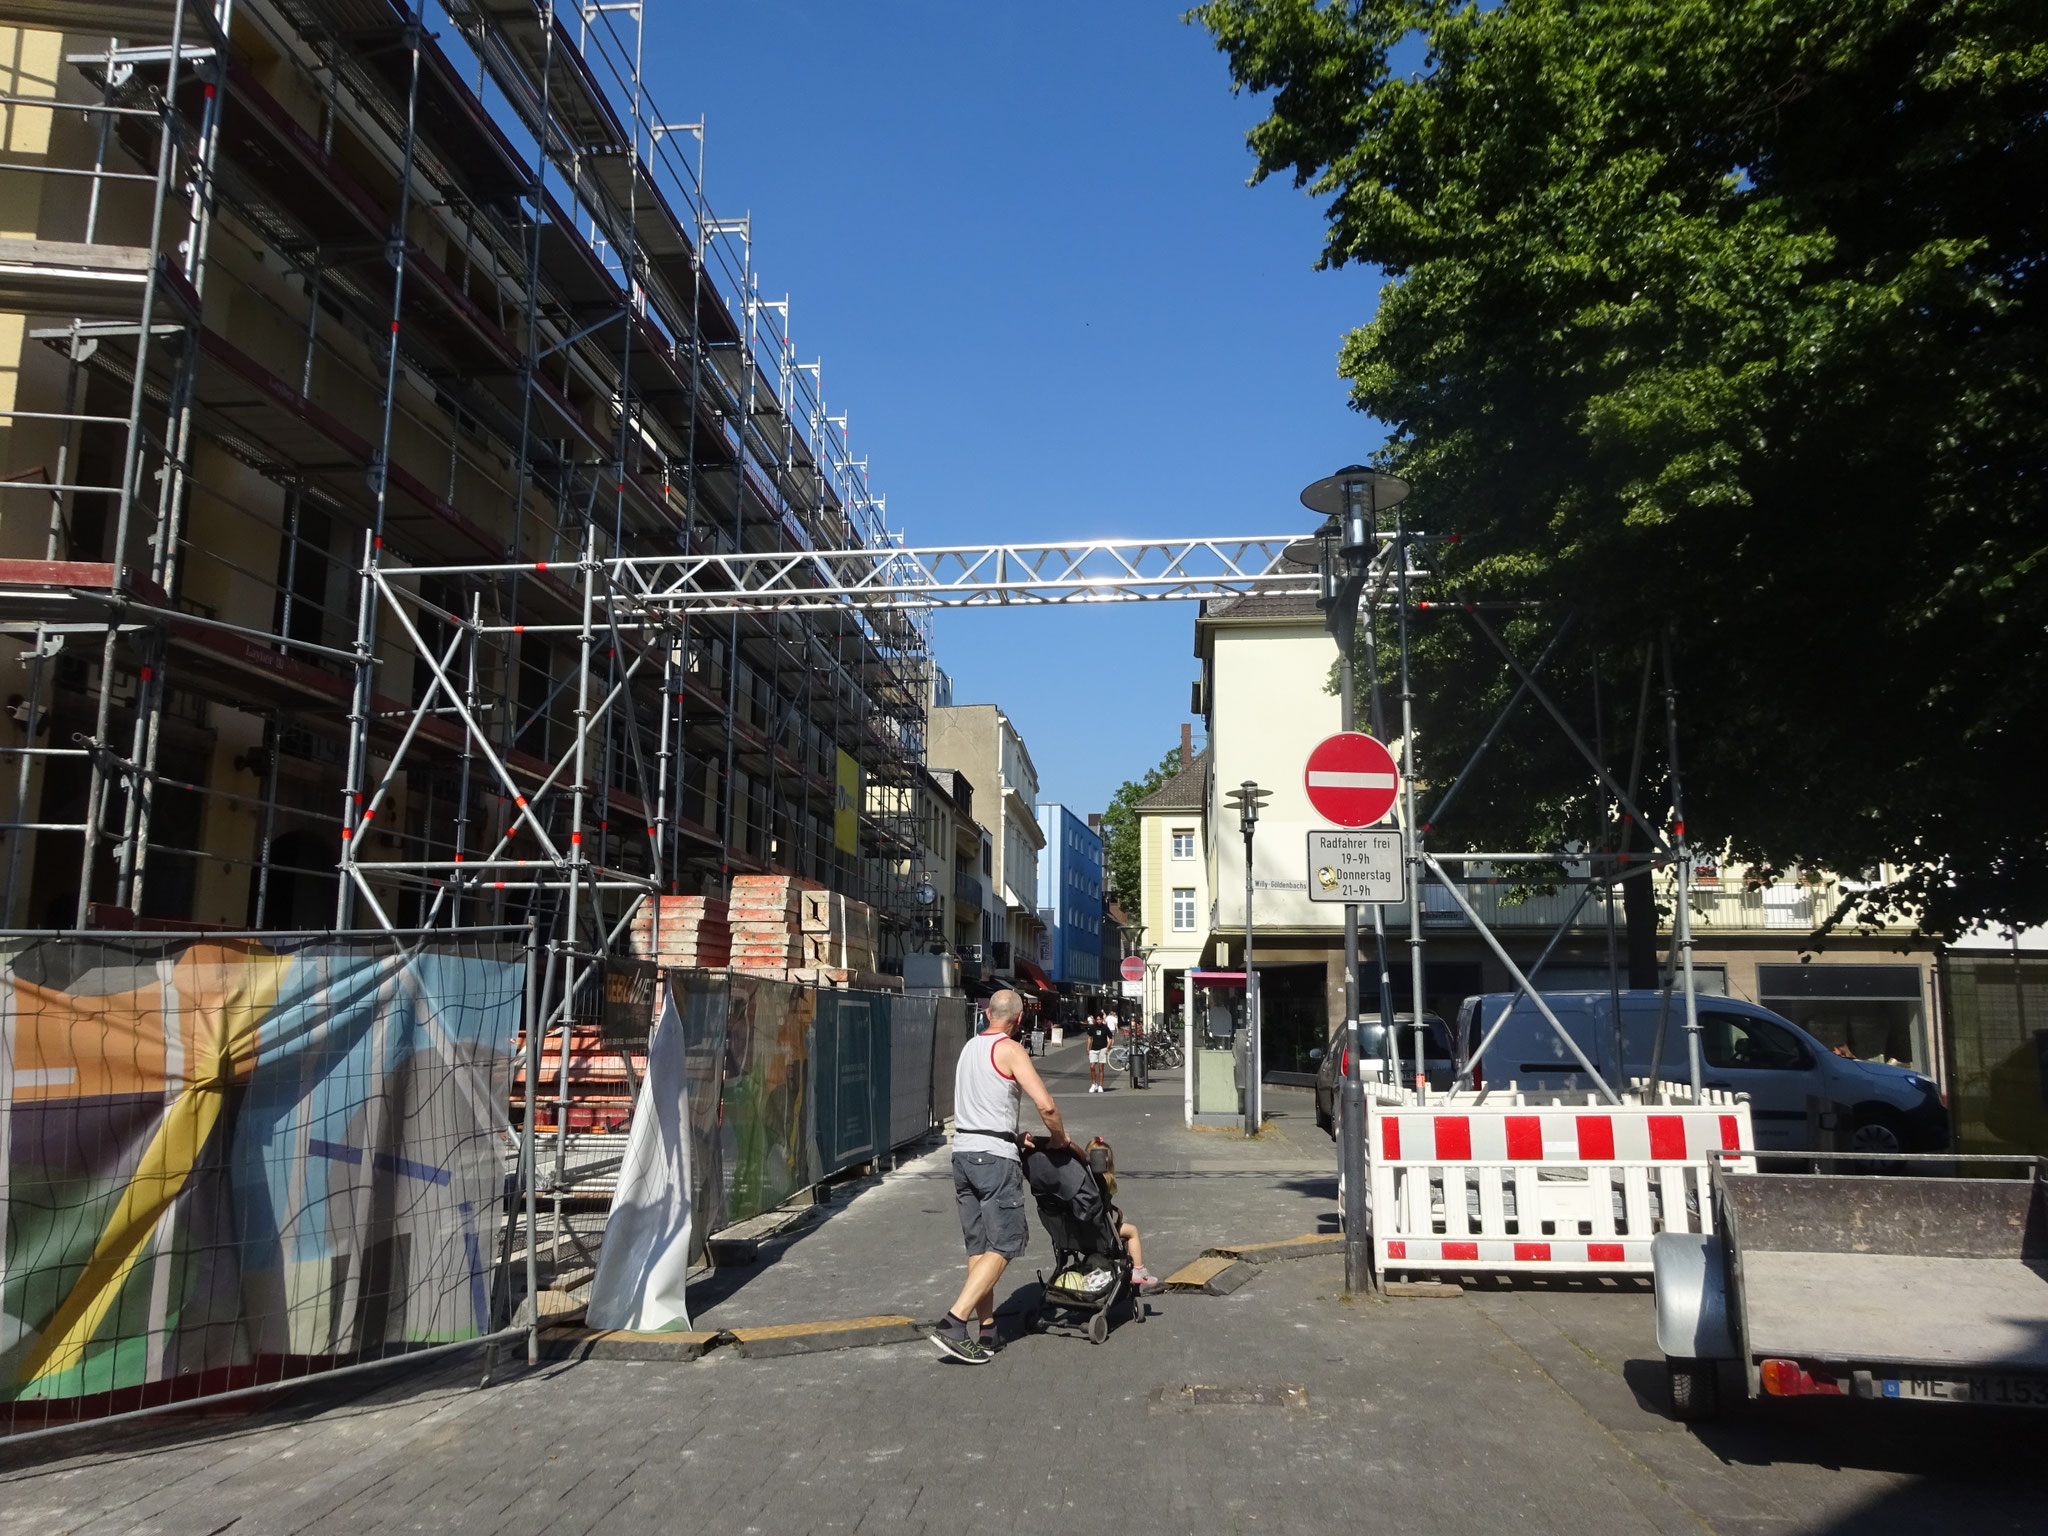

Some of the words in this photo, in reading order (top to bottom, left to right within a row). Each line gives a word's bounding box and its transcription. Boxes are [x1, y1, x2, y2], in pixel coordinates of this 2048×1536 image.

[1320, 837, 1367, 848] Radfahrer
[1373, 837, 1390, 848] frei
[1342, 853, 1370, 864] 19-9h
[1336, 868, 1391, 882] Donnerstag
[1342, 884, 1371, 895] 21-9h
[1911, 1375, 1948, 1398] ME
